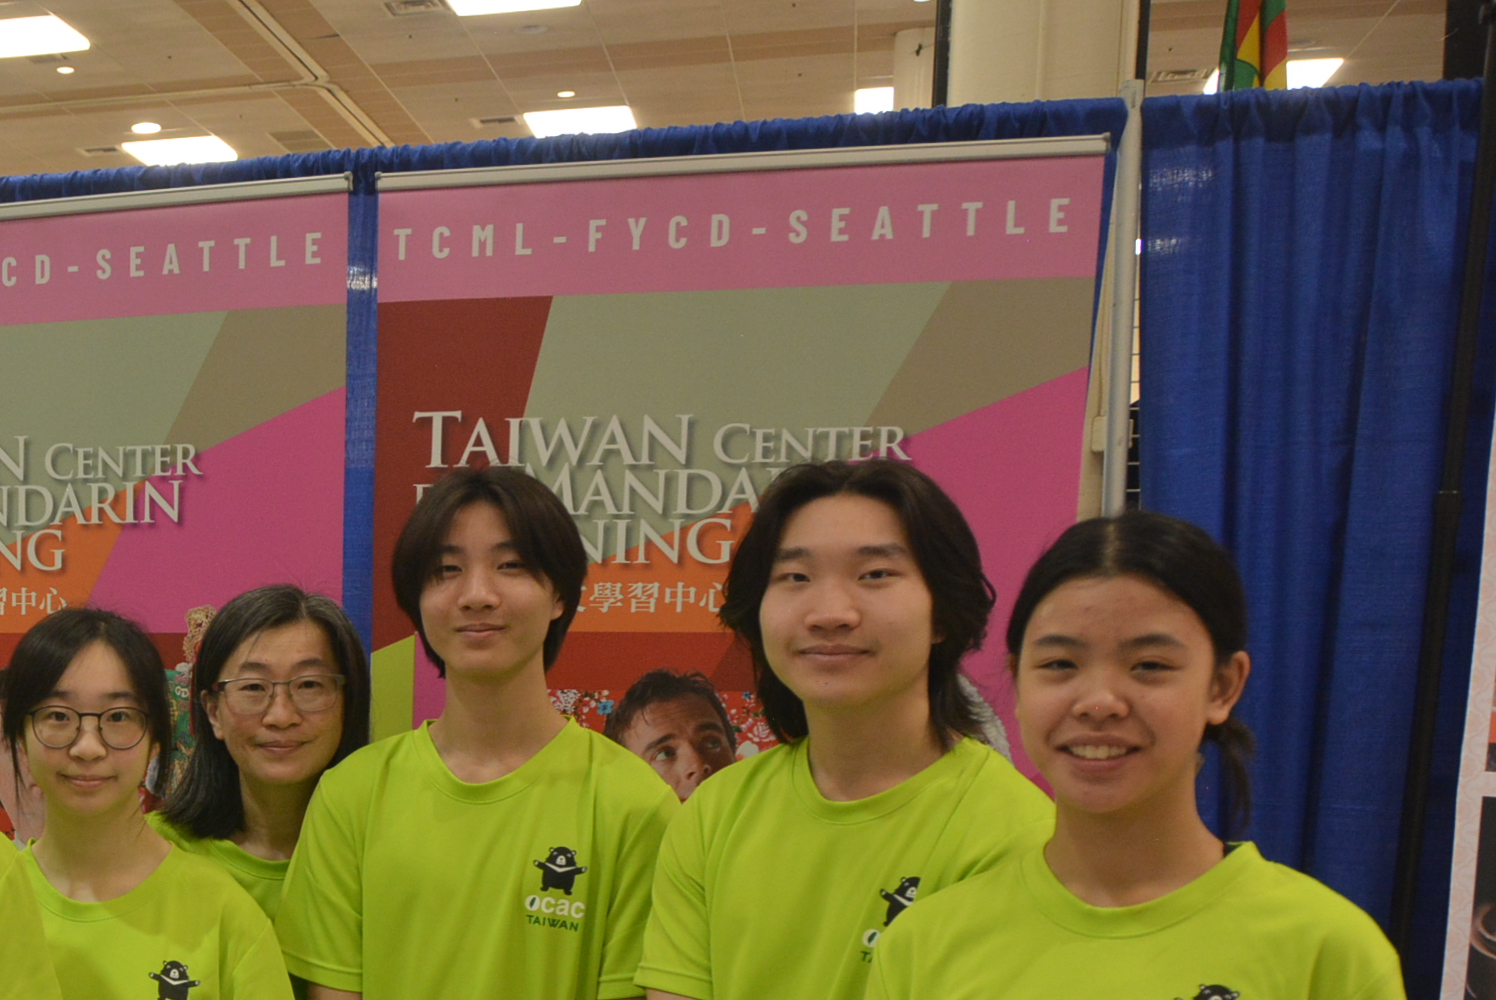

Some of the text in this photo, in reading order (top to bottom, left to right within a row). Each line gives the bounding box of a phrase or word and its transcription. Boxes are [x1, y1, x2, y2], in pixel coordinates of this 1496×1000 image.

[394, 197, 1071, 262] TCML-FYCD-SEATTLE
[413, 410, 912, 470] TAIWAN CENTER
[45, 443, 203, 482] CENTER
[524, 894, 586, 919] ocac
[525, 914, 580, 932] TAIWAN
